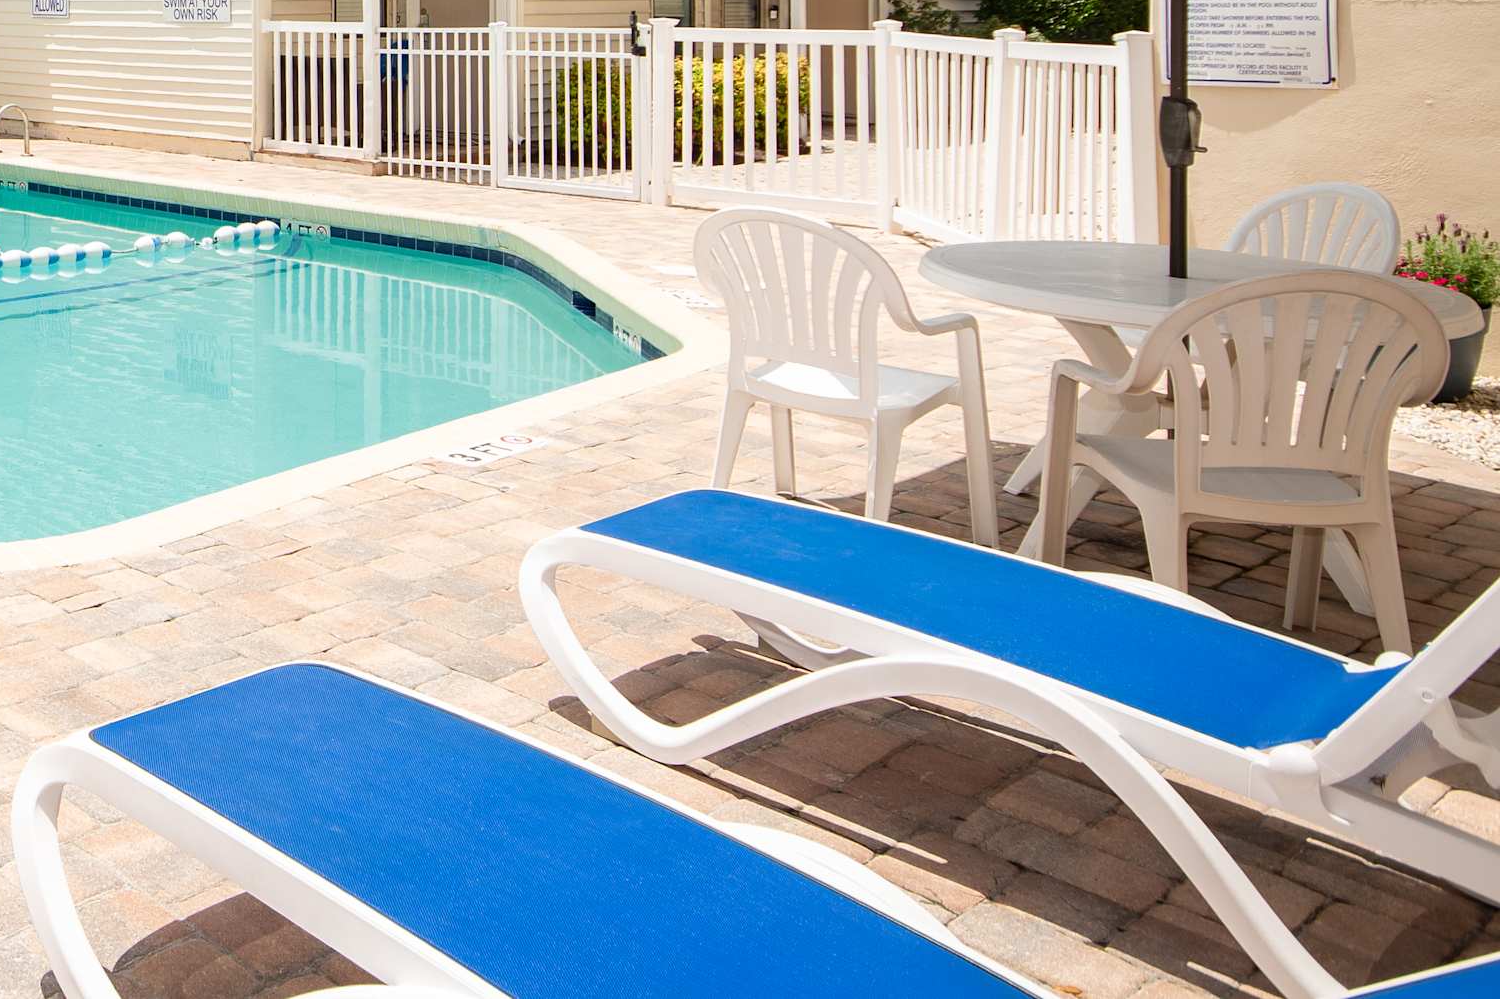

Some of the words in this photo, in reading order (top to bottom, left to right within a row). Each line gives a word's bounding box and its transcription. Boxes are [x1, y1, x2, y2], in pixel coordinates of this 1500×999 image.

[174, 8, 195, 20] OWN
[197, 8, 218, 20] RISK
[449, 454, 482, 462] 3
[469, 442, 512, 456] FT
